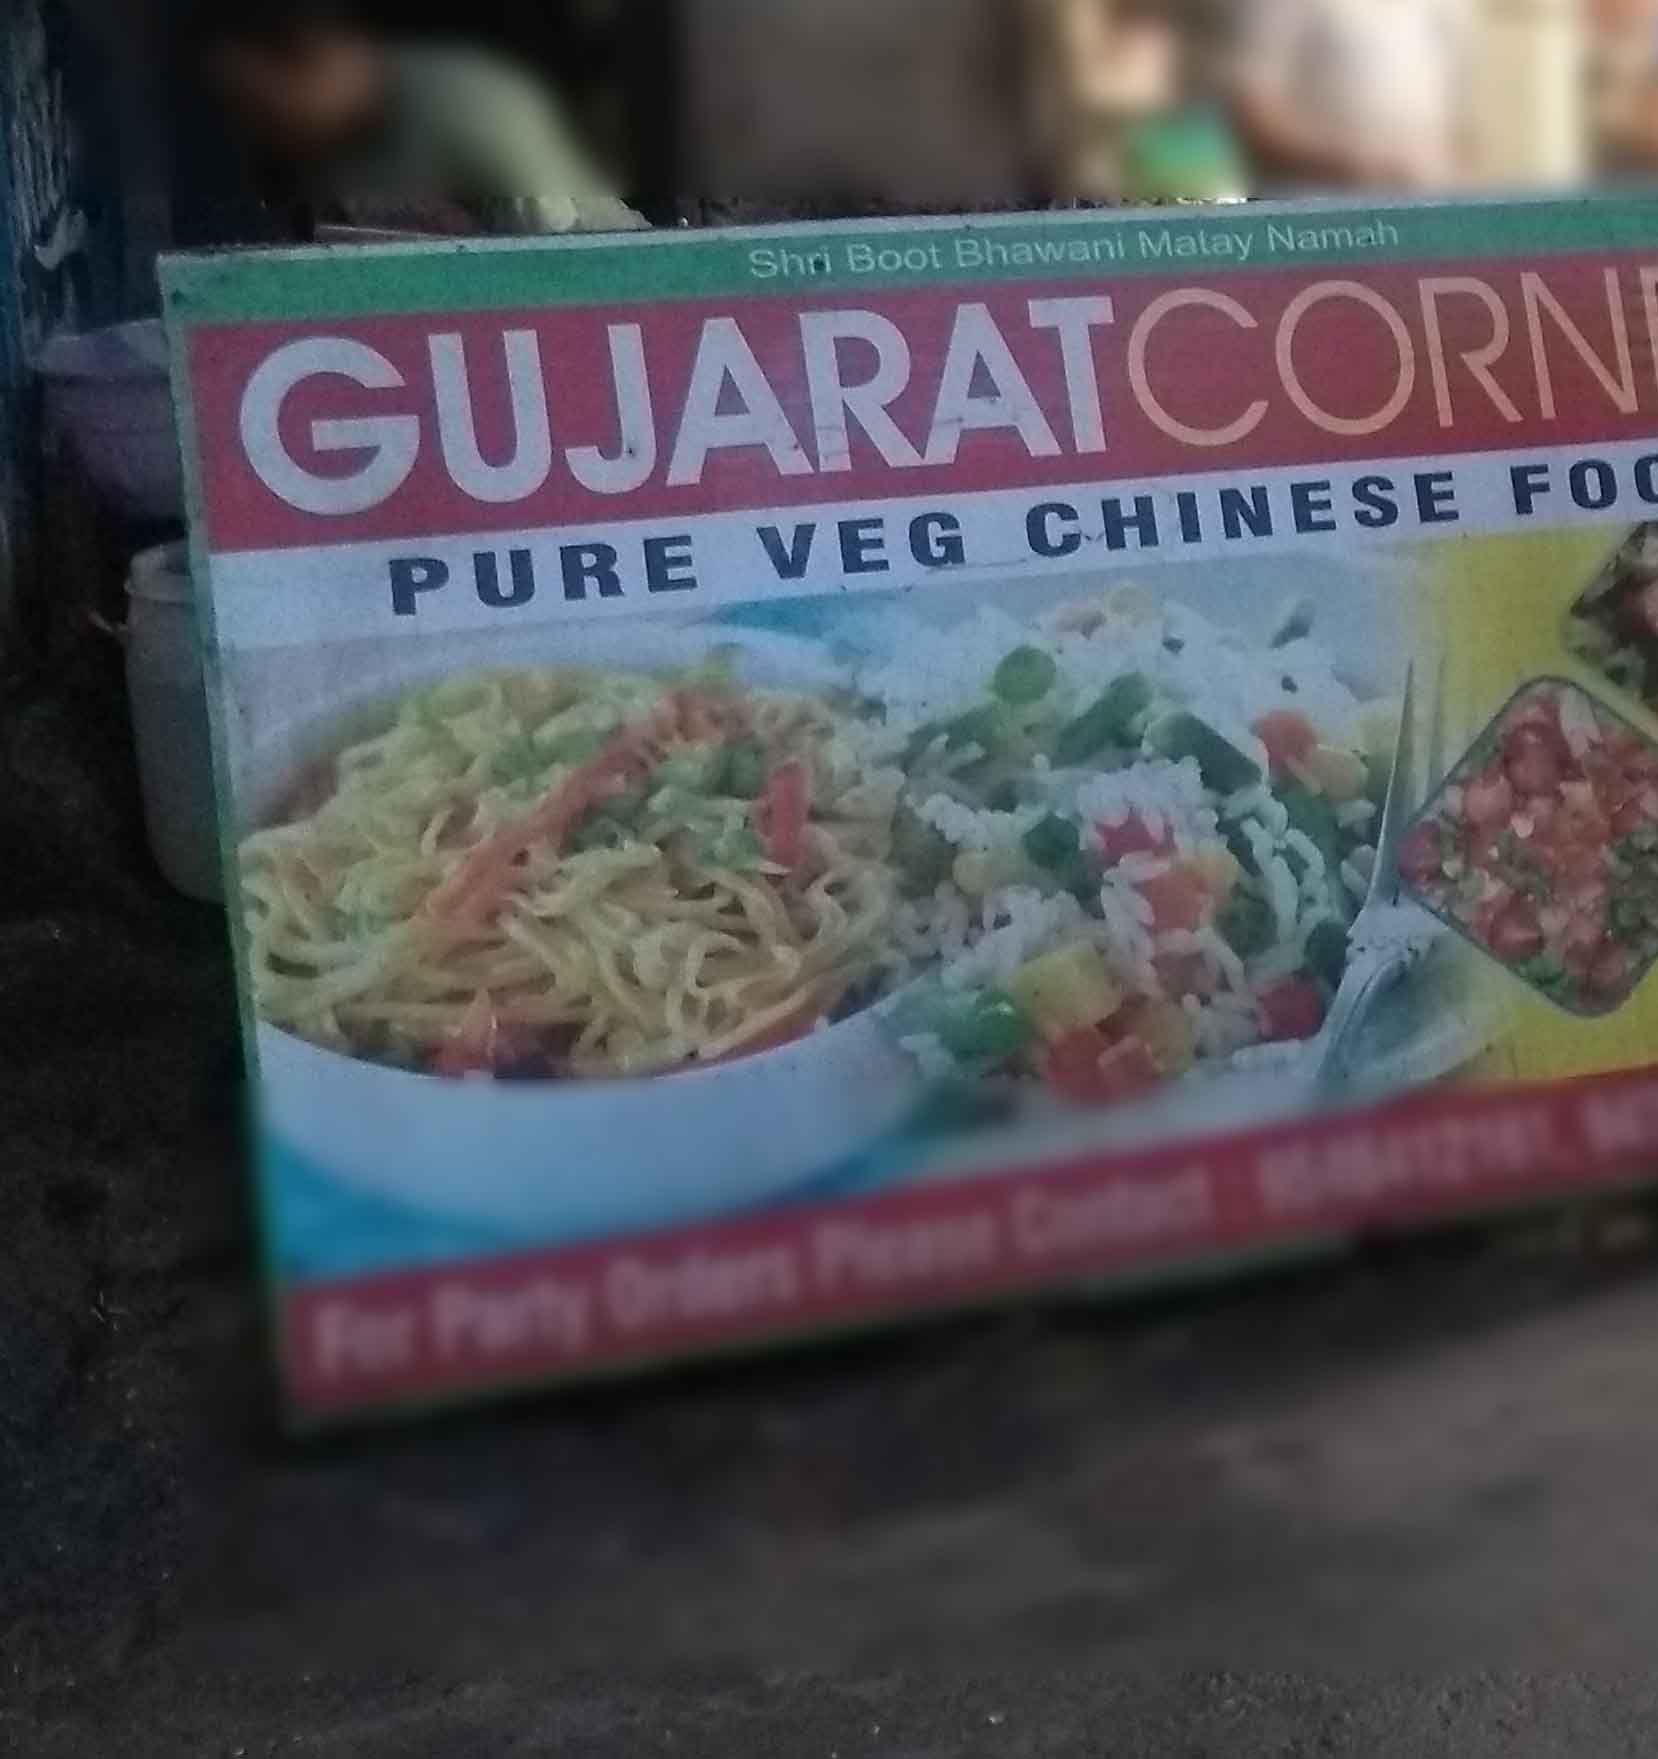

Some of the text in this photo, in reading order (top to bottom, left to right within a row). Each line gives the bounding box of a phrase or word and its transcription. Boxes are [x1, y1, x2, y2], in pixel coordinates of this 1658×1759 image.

[747, 220, 1400, 280] Shri Boot Bhawani Matay Namah
[389, 534, 699, 616] PURE
[755, 511, 967, 580] VEG
[1025, 471, 1462, 559] CHINESE
